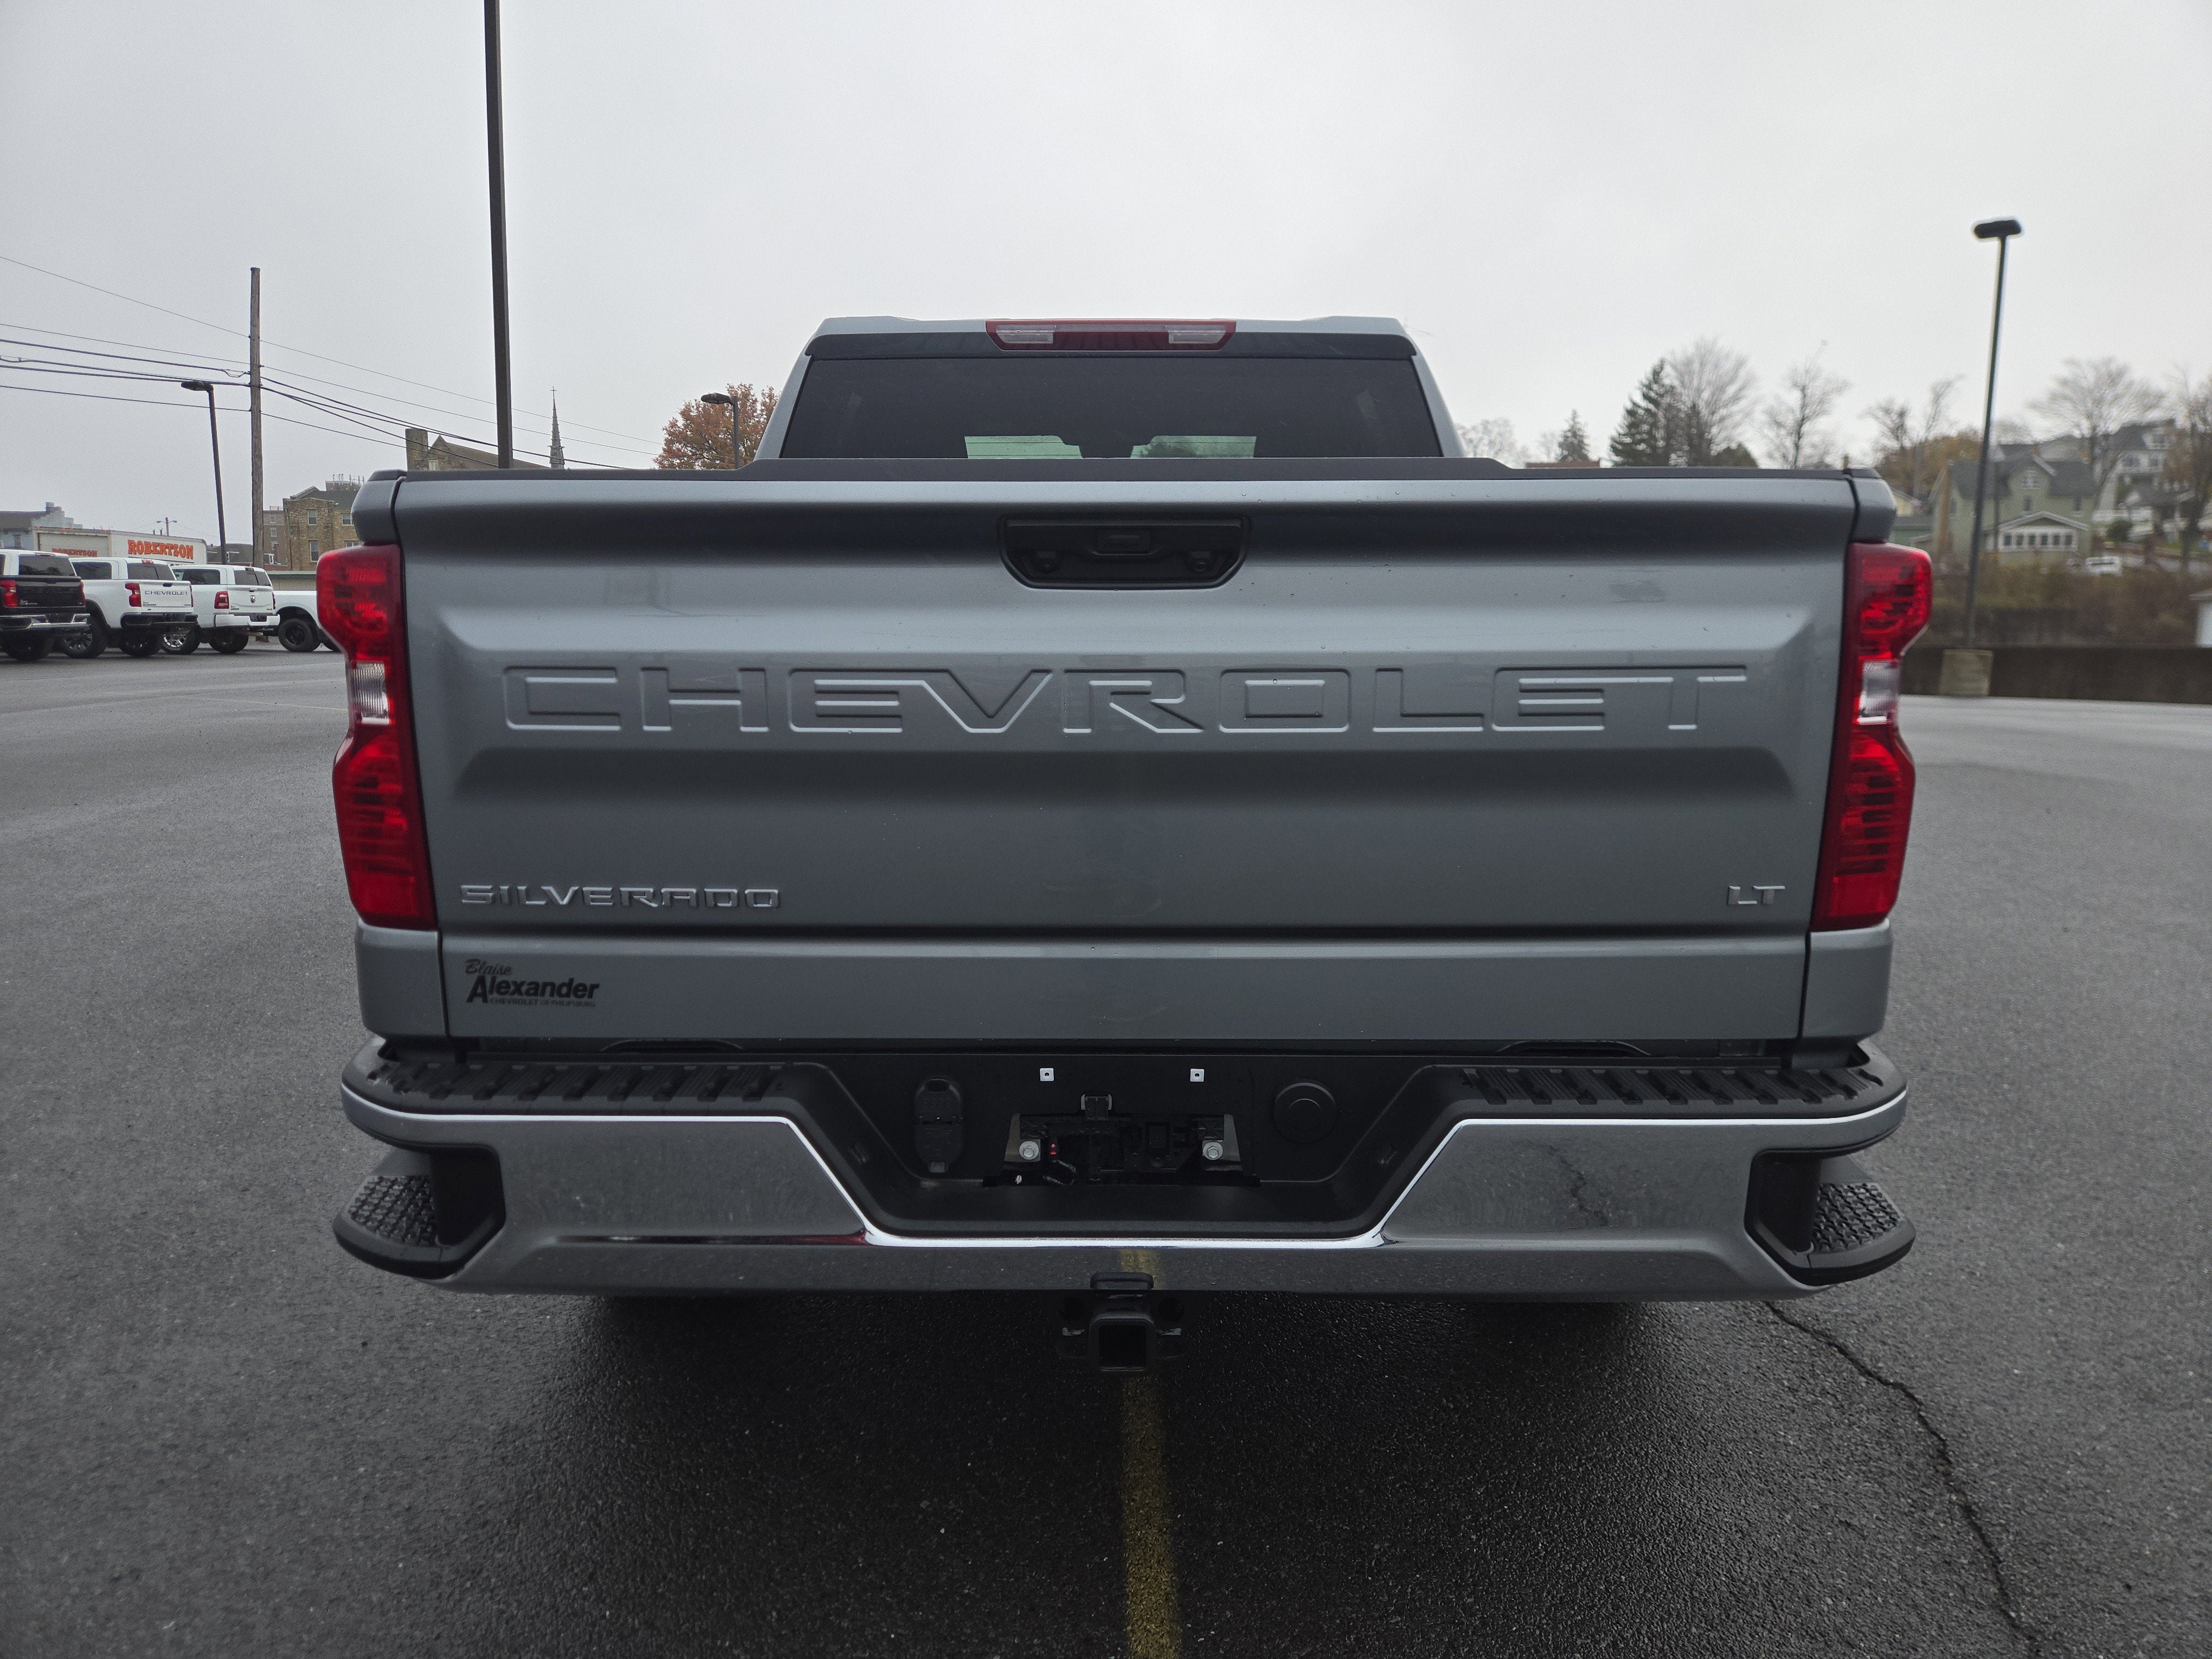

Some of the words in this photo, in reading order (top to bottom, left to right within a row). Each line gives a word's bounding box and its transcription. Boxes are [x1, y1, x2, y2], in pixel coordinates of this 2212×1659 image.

[127, 539, 194, 559] ROBERTSON
[503, 666, 1748, 736] CHEVROLET
[460, 884, 780, 908] SILVERADO
[1728, 885, 1786, 905] LT
[465, 959, 512, 976] Blaise
[466, 975, 600, 1004] Alexander
